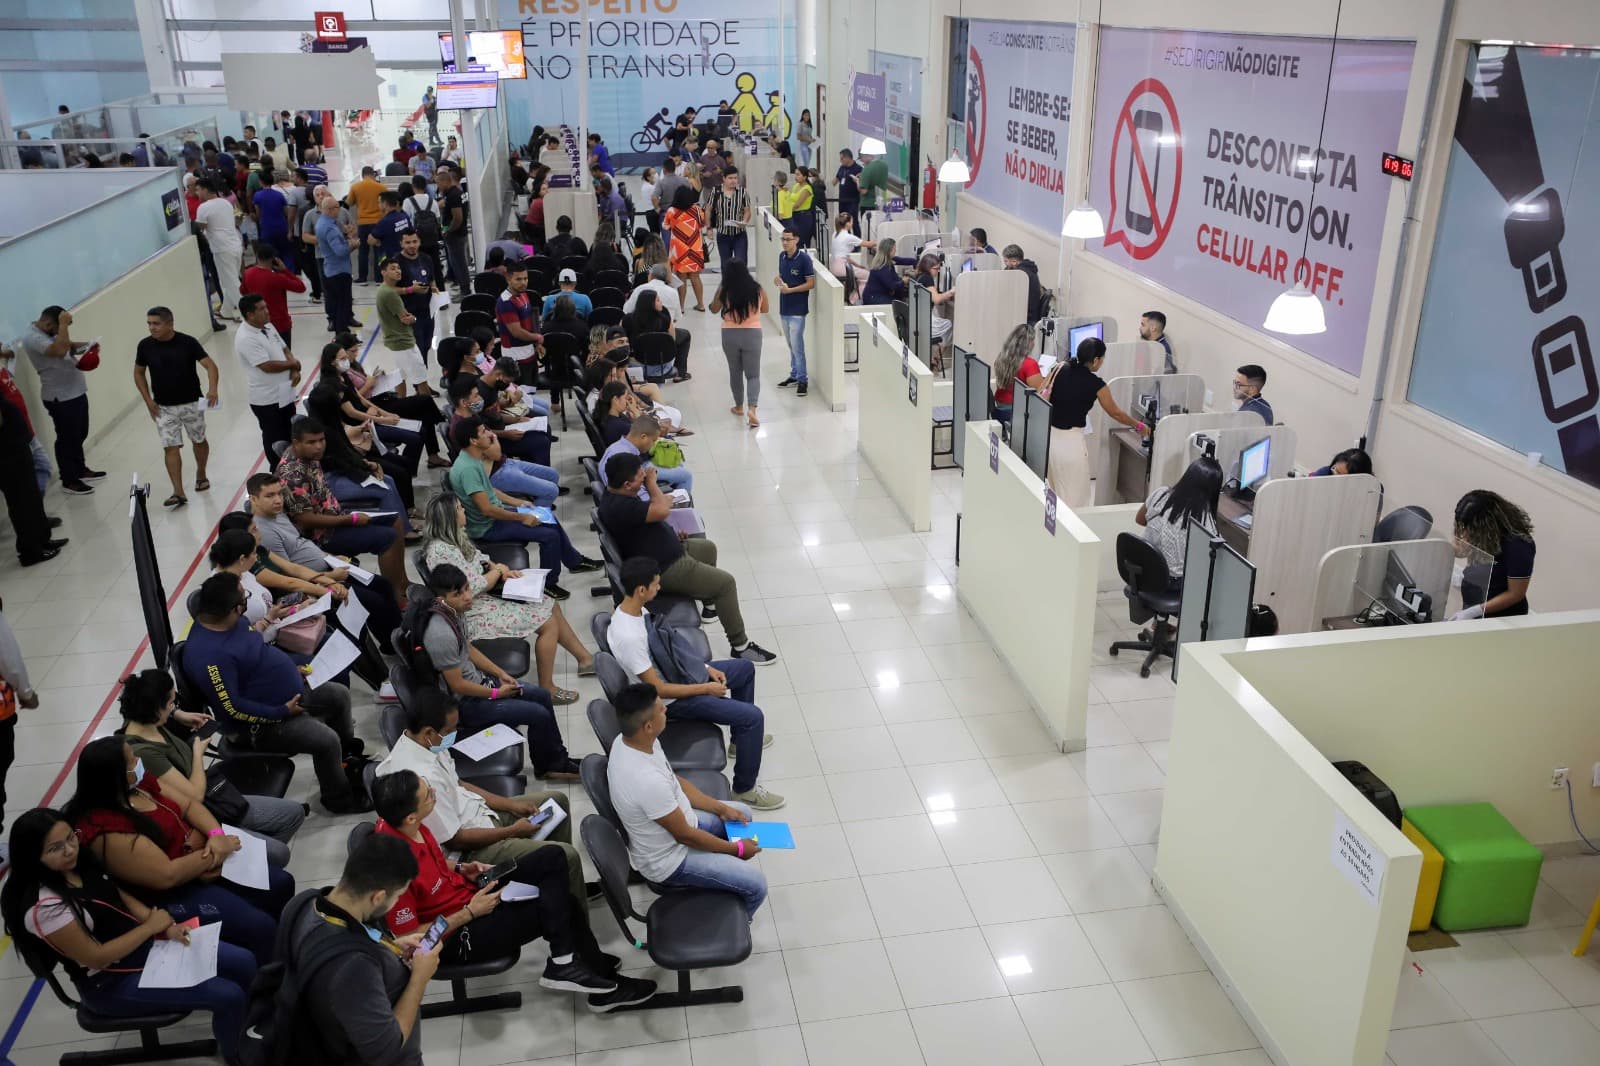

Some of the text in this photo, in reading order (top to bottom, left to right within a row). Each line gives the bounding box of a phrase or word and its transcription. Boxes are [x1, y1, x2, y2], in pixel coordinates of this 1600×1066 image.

[521, 16, 538, 47] É
[524, 55, 571, 79] NO
[1164, 46, 1300, 78] #SEDIRIGIRNÃODIGITE
[1007, 120, 1058, 160] SE BEBER,
[1005, 149, 1064, 195] NÃO DIRIJA
[1207, 127, 1357, 192] DESCONECTA
[1203, 172, 1353, 251] TRÂNSITO ON.
[1197, 223, 1344, 306] CELULAR OFF.
[1046, 500, 1056, 521] 08
[207, 665, 222, 684] JESUS
[214, 683, 225, 692] IS
[218, 690, 229, 701] MY
